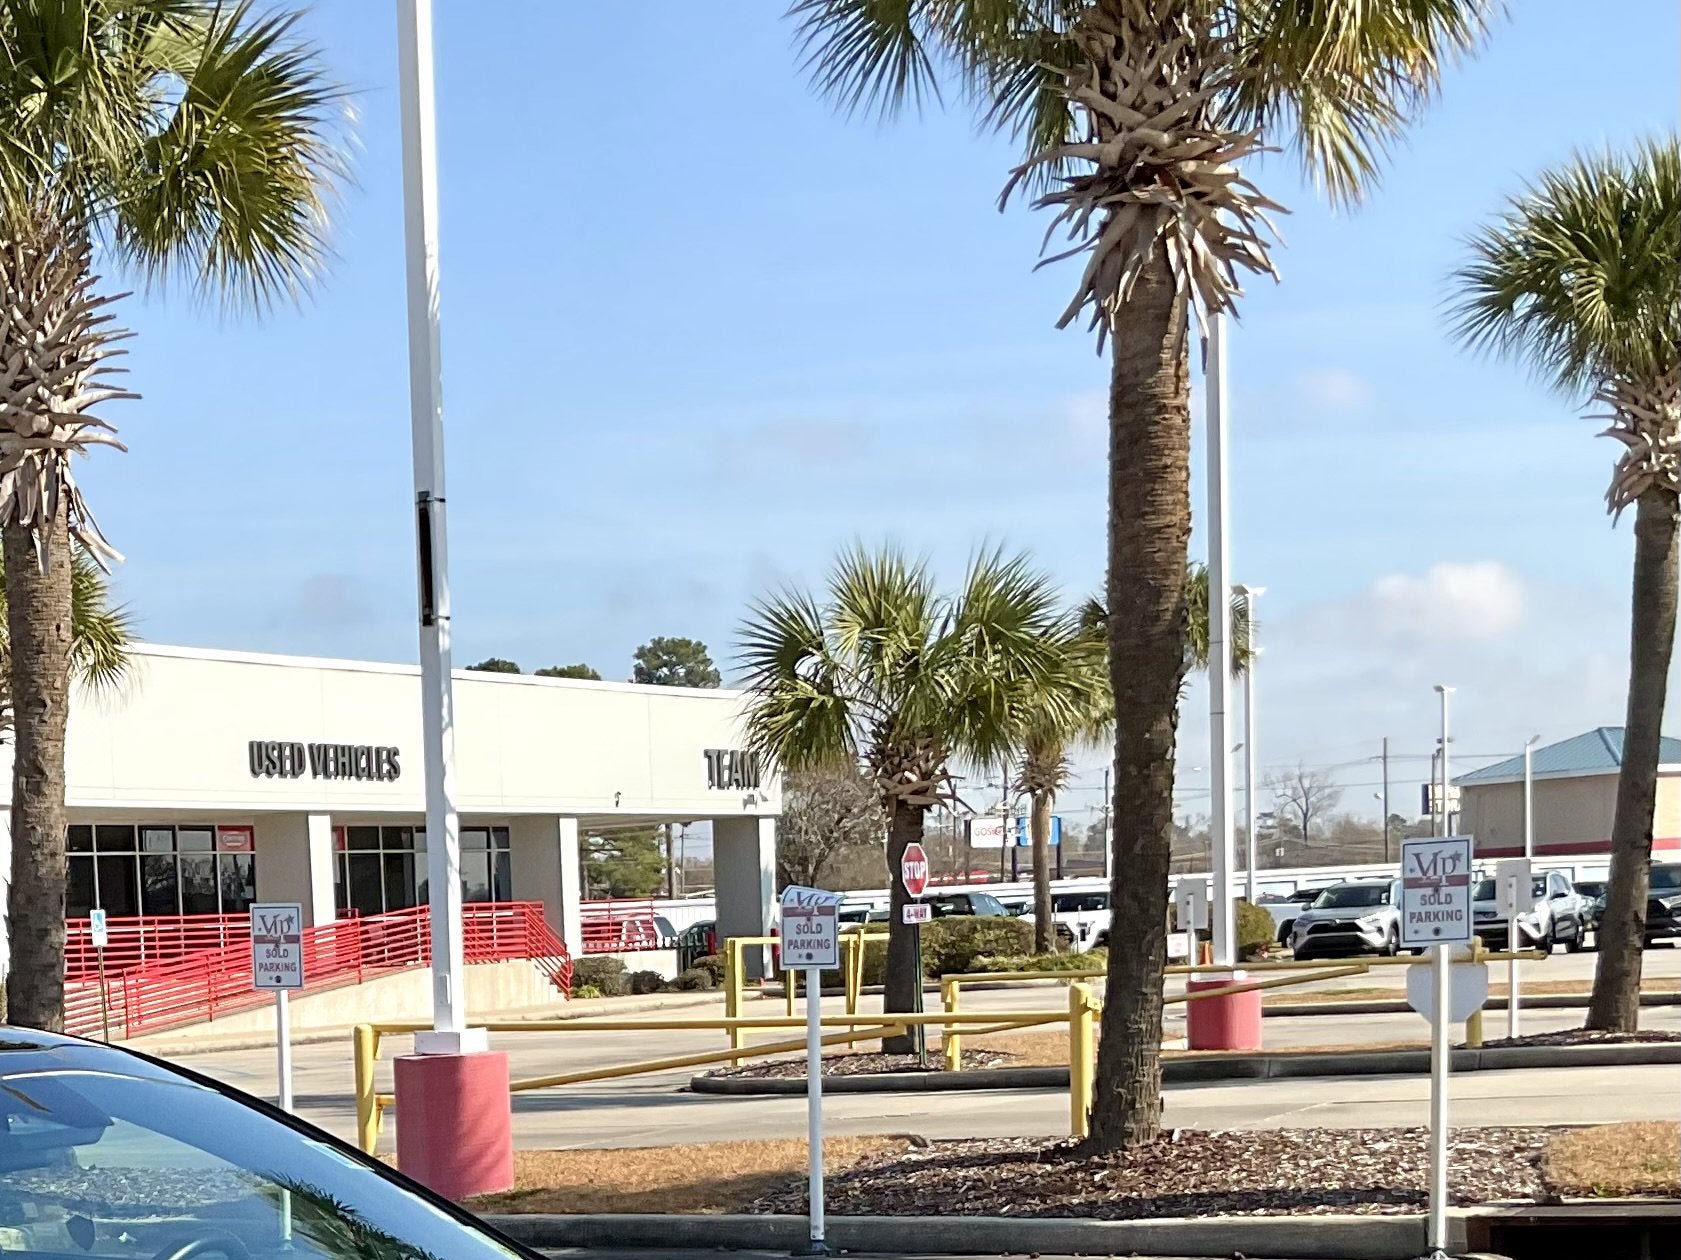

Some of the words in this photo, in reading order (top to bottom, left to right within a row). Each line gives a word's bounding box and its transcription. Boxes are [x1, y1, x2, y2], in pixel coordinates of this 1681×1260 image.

[248, 741, 306, 779] USED
[307, 743, 401, 782] VEHICLES
[704, 749, 760, 790] TEAM
[904, 861, 926, 880] STOP
[1420, 893, 1453, 906] SOLD
[1409, 909, 1463, 924] PARKING
[795, 923, 823, 935] SOLD
[787, 939, 831, 950] PARKING
[265, 948, 289, 959] SOLD
[258, 962, 297, 973] PARKING
